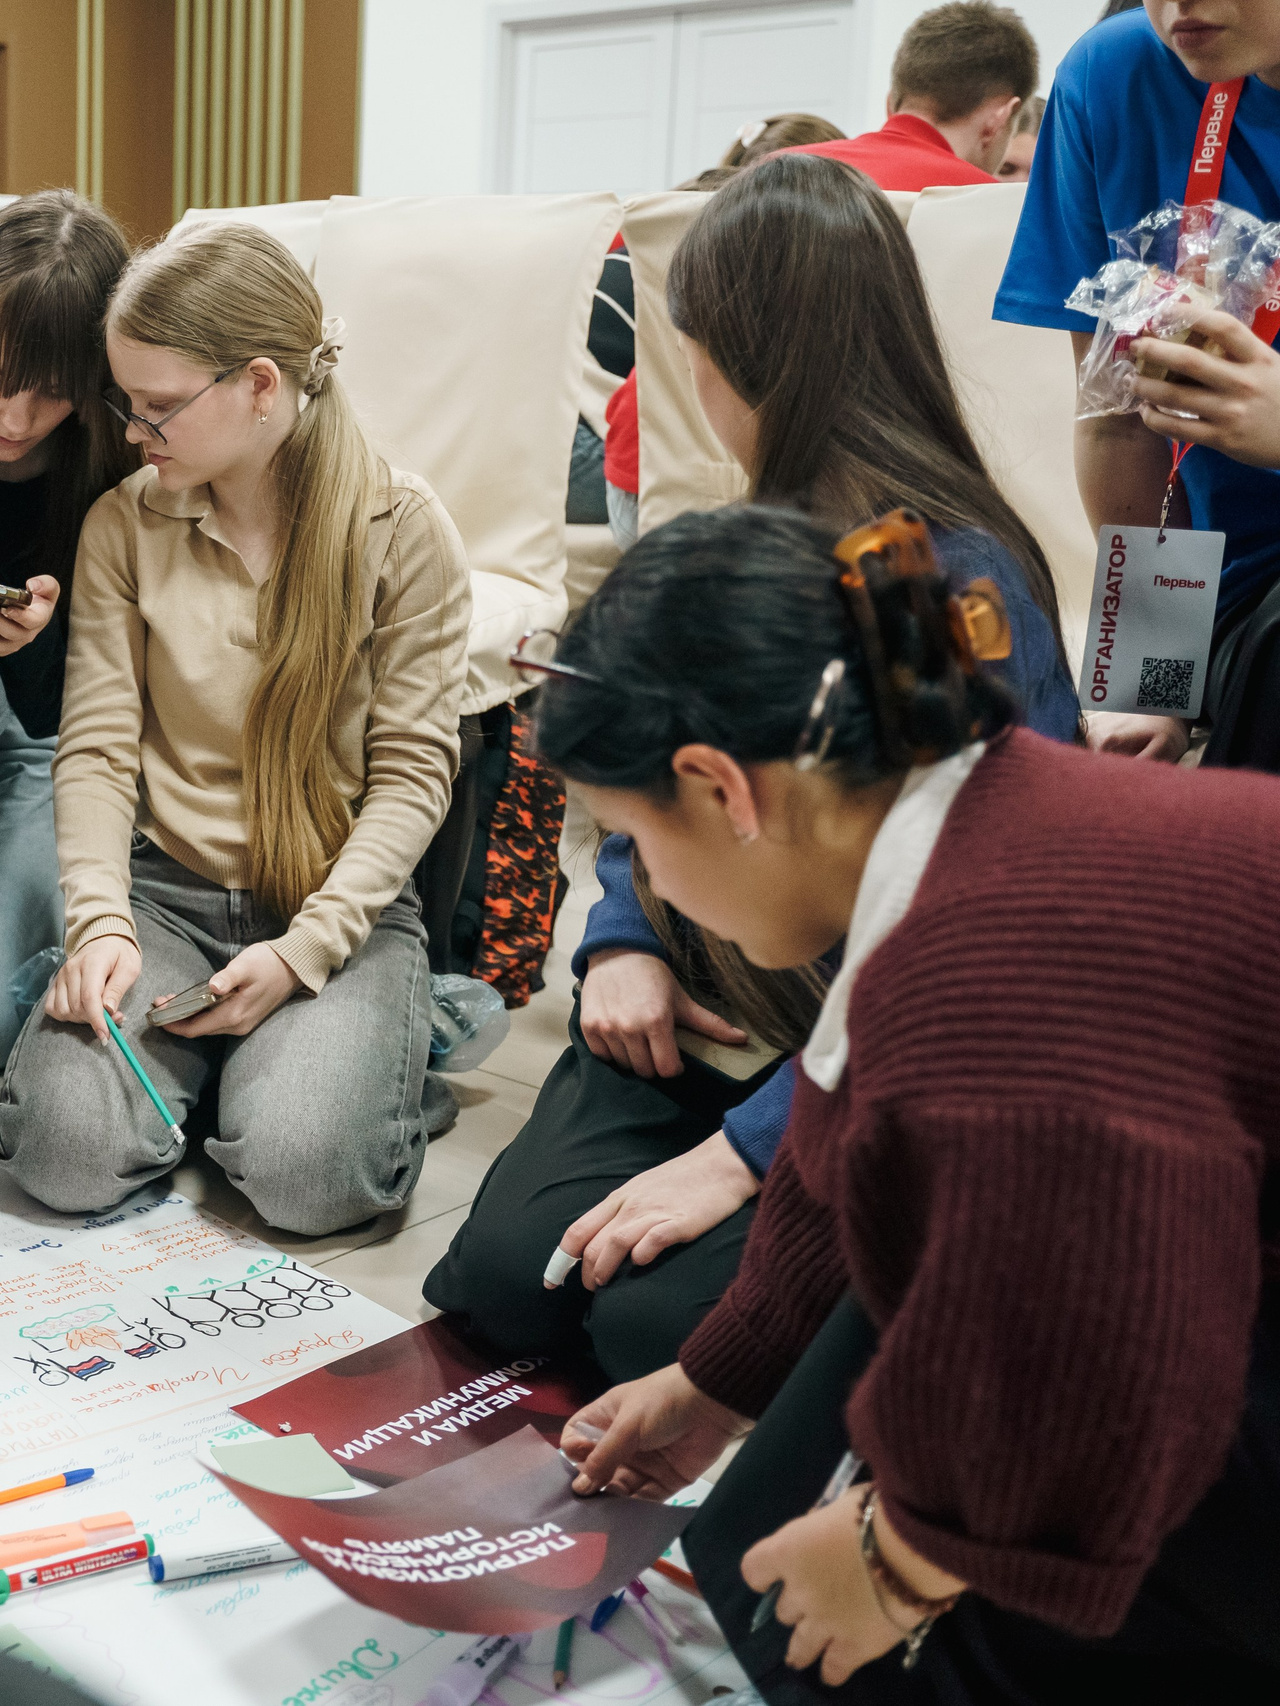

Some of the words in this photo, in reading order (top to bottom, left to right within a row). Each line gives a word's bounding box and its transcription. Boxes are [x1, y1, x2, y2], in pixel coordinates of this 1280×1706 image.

[1194, 93, 1228, 173] Первые
[1153, 575, 1206, 590] Первые
[1090, 534, 1127, 703] ОРГАНИЗАТОР
[258, 1329, 365, 1368] Дружба
[332, 1356, 550, 1460] КОММУНИКАЦИИ
[431, 1384, 533, 1433] МЕДИА
[410, 1430, 443, 1447] И
[343, 1527, 483, 1553] ПАМЯТЬ
[41, 1560, 73, 1582] ULTRA
[74, 1547, 138, 1574] WHITEBOARD
[206, 1561, 232, 1571] ДОСКИ
